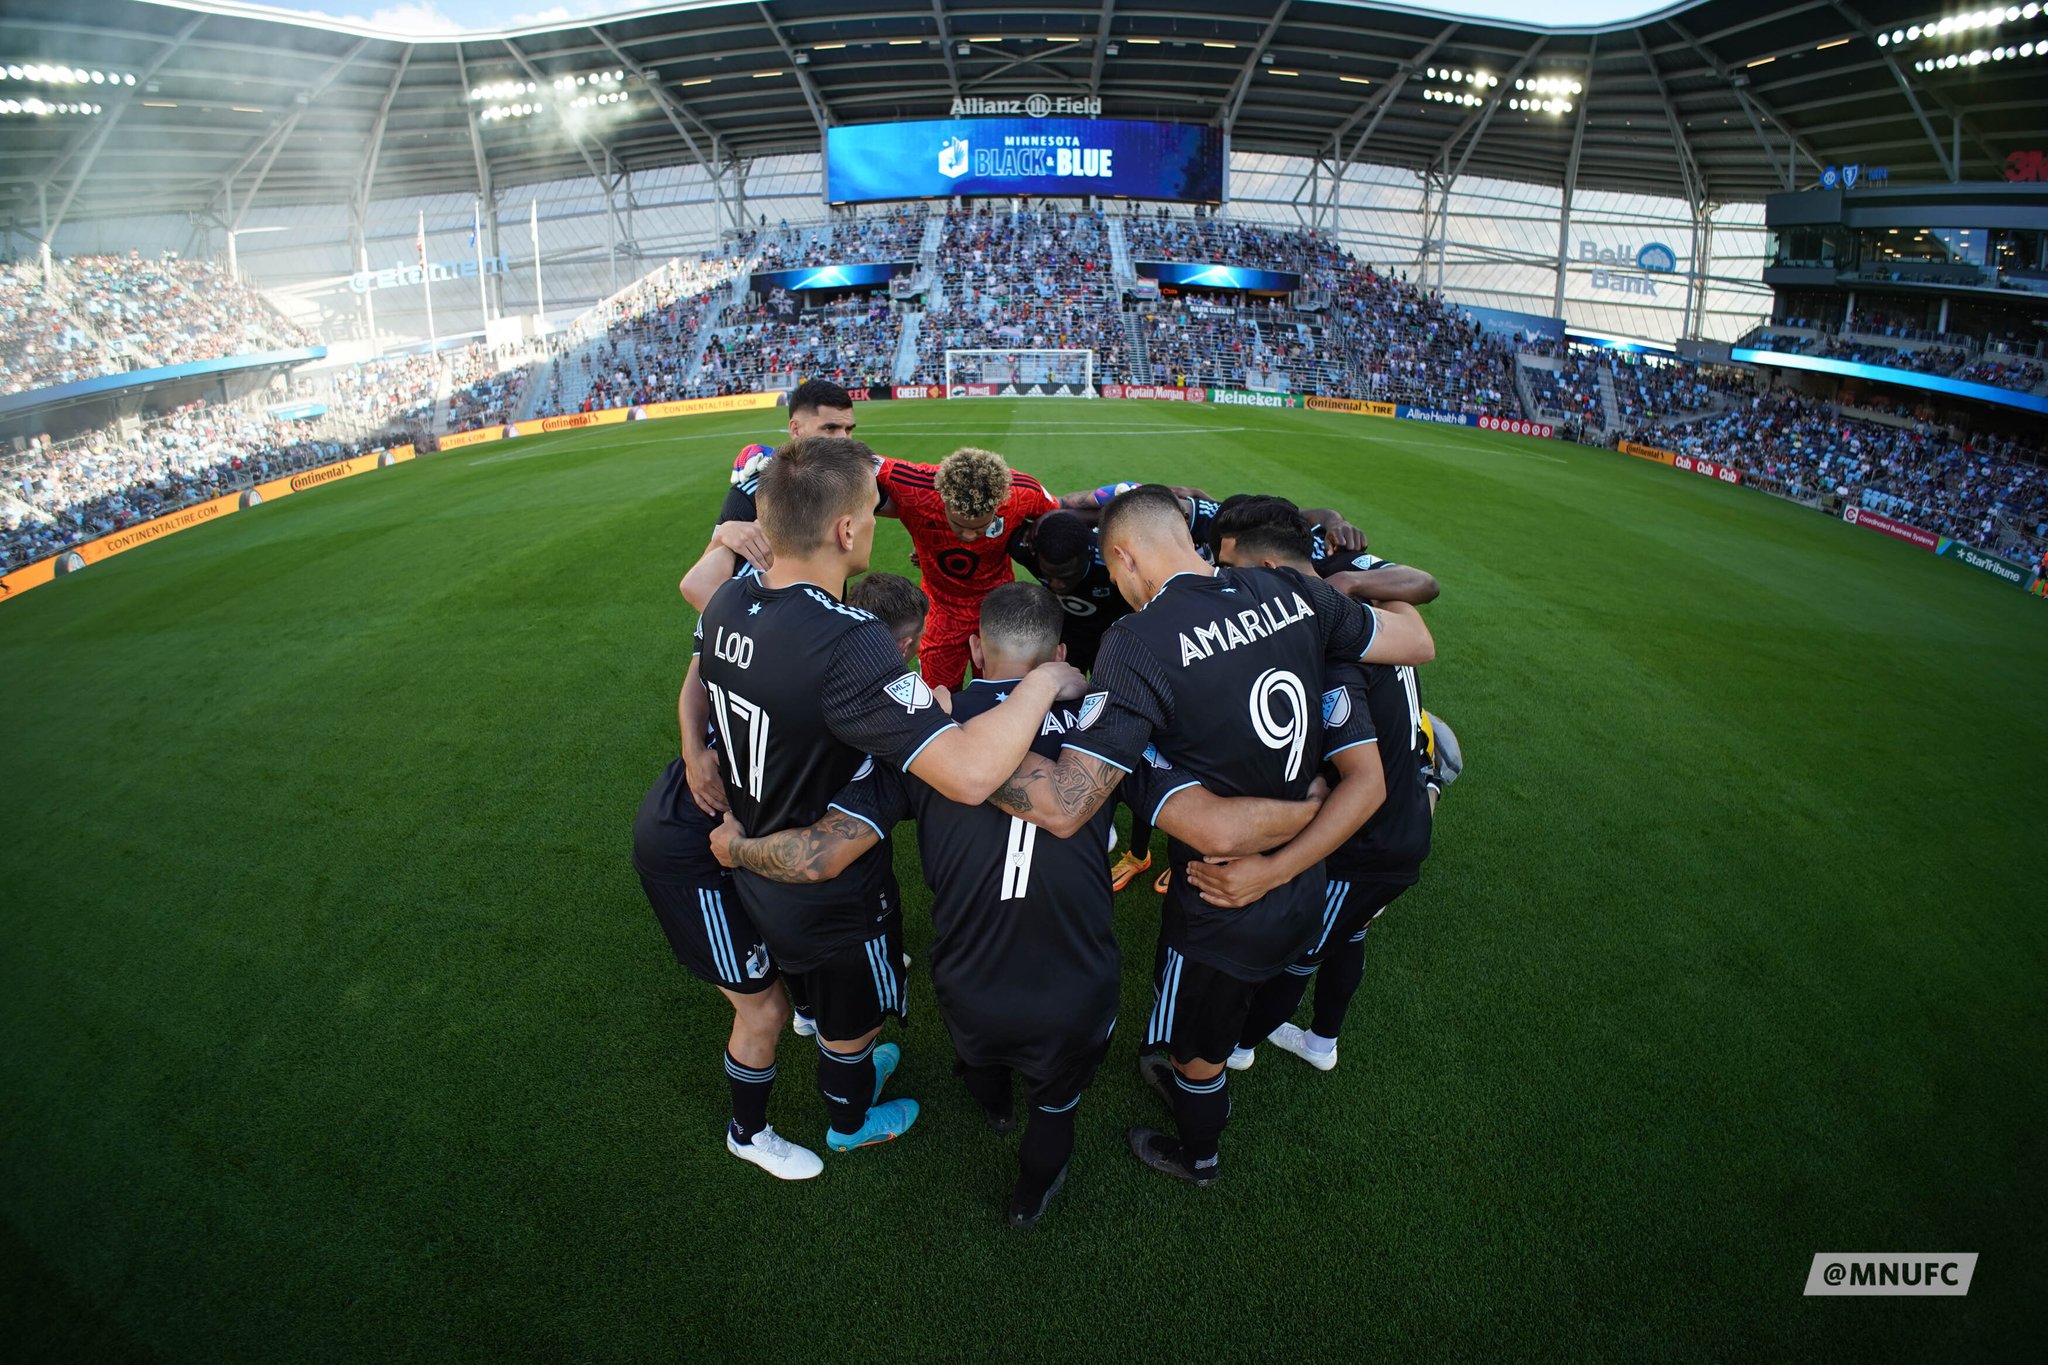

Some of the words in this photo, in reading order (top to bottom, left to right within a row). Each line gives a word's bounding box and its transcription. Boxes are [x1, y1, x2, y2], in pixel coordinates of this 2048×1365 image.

[950, 97, 1021, 115] Allianz
[1056, 96, 1102, 115] Field
[1005, 136, 1080, 147] MINNESOTA
[975, 148, 1046, 177] BLACK
[1046, 156, 1055, 167] &
[1057, 149, 1113, 177] BLUE
[1869, 168, 1888, 181] MN
[1578, 240, 1631, 267] Bell
[1591, 268, 1658, 297] Bank
[1190, 305, 1209, 313] DARK
[1210, 307, 1236, 315] CLOUDS
[1126, 386, 1154, 400] Captain
[1154, 387, 1184, 401] Morgan
[1214, 389, 1282, 407] Heineken
[1306, 397, 1363, 414] Continental
[1371, 403, 1393, 415] TIRE
[541, 415, 592, 432] Continental
[1406, 407, 1433, 422] Allina
[1434, 410, 1458, 424] Health
[1626, 442, 1660, 459] Continental
[290, 465, 345, 492] Continental
[1675, 455, 1692, 470] Cub
[1696, 461, 1714, 477] Cub
[1719, 468, 1737, 484] Cub
[108, 505, 219, 552] CONTINENTALTIRE.COM
[1859, 513, 1890, 532] Coordinated
[1891, 524, 1912, 539] Business
[1912, 533, 1934, 547] Systems
[1965, 552, 2020, 582] StarTribune
[1179, 592, 1315, 668] AMARILLA
[714, 626, 754, 670] LOD
[891, 679, 911, 693] MLS
[1249, 667, 1308, 783] 9
[707, 680, 770, 803] 17
